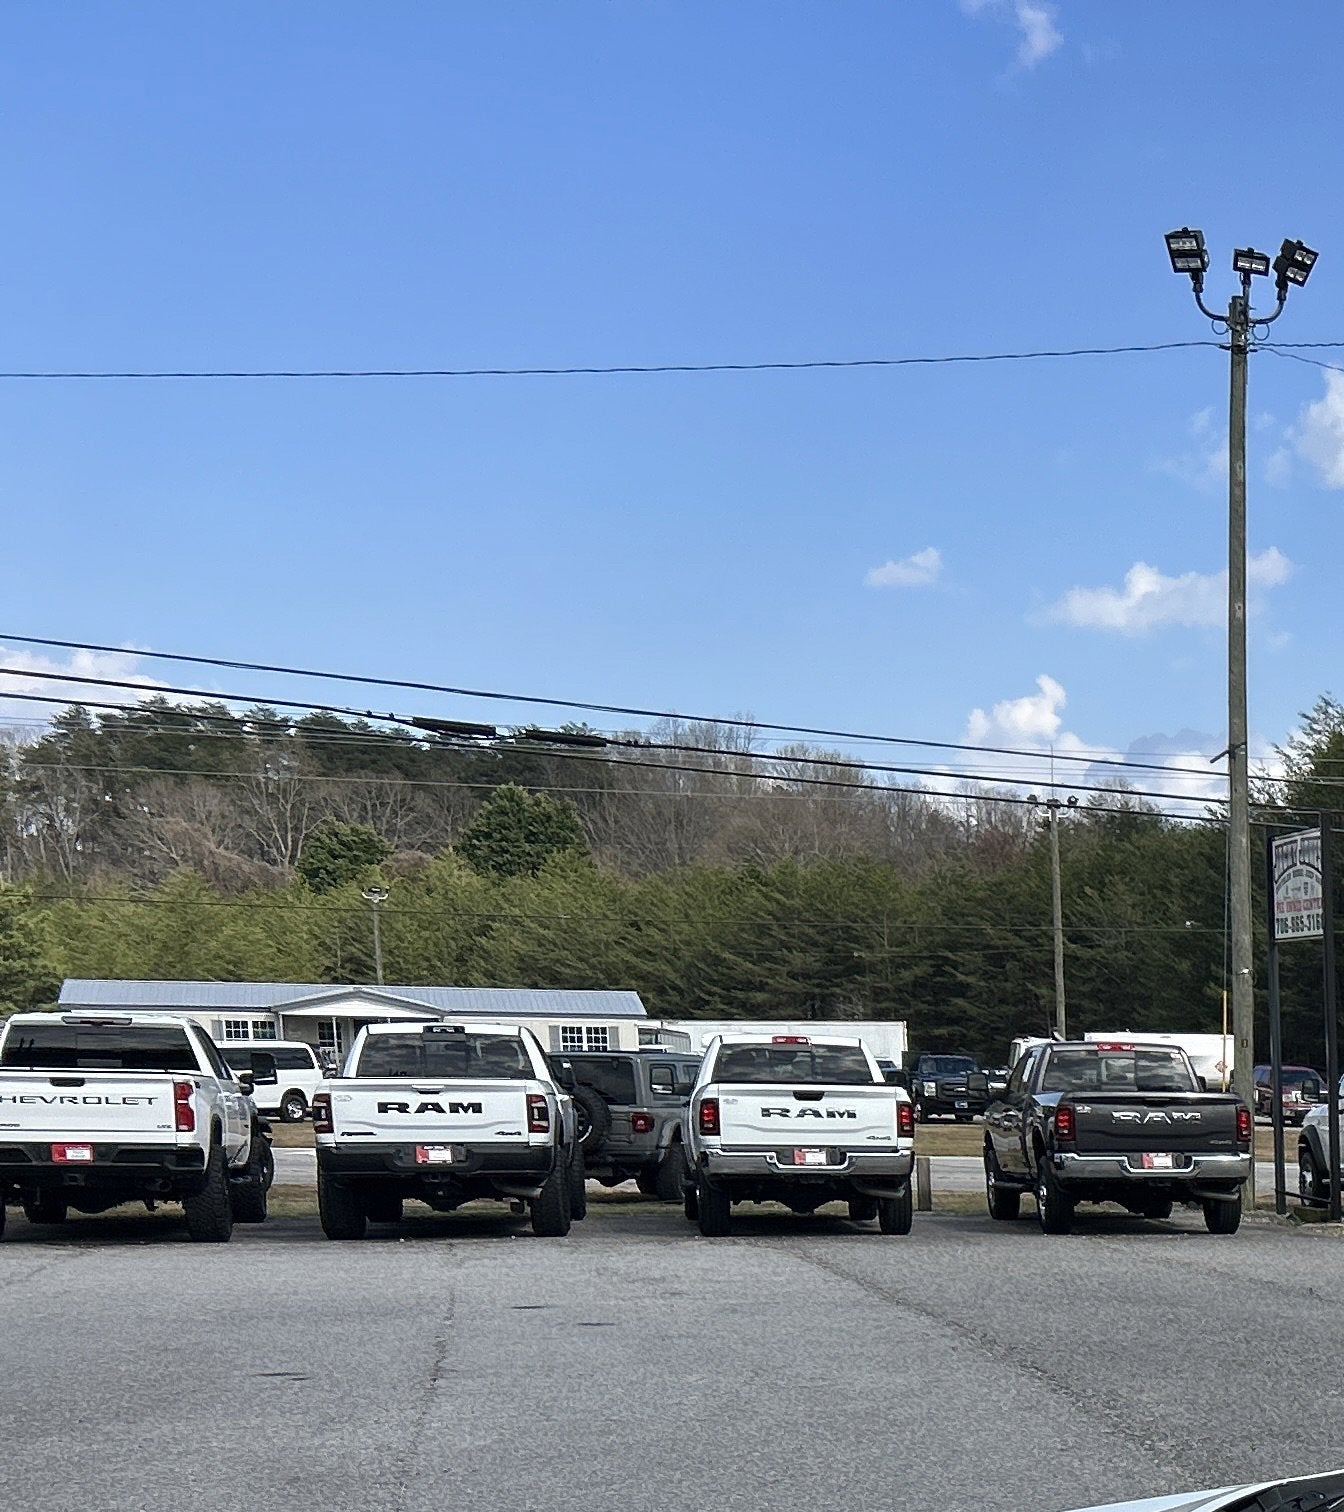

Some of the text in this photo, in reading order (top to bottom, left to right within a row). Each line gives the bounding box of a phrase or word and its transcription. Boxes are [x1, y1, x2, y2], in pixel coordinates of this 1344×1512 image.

[0, 1095, 158, 1105] HEVROLET
[377, 1101, 483, 1114] RAM
[760, 1106, 857, 1119] RAM
[1111, 1111, 1201, 1124] RAM
